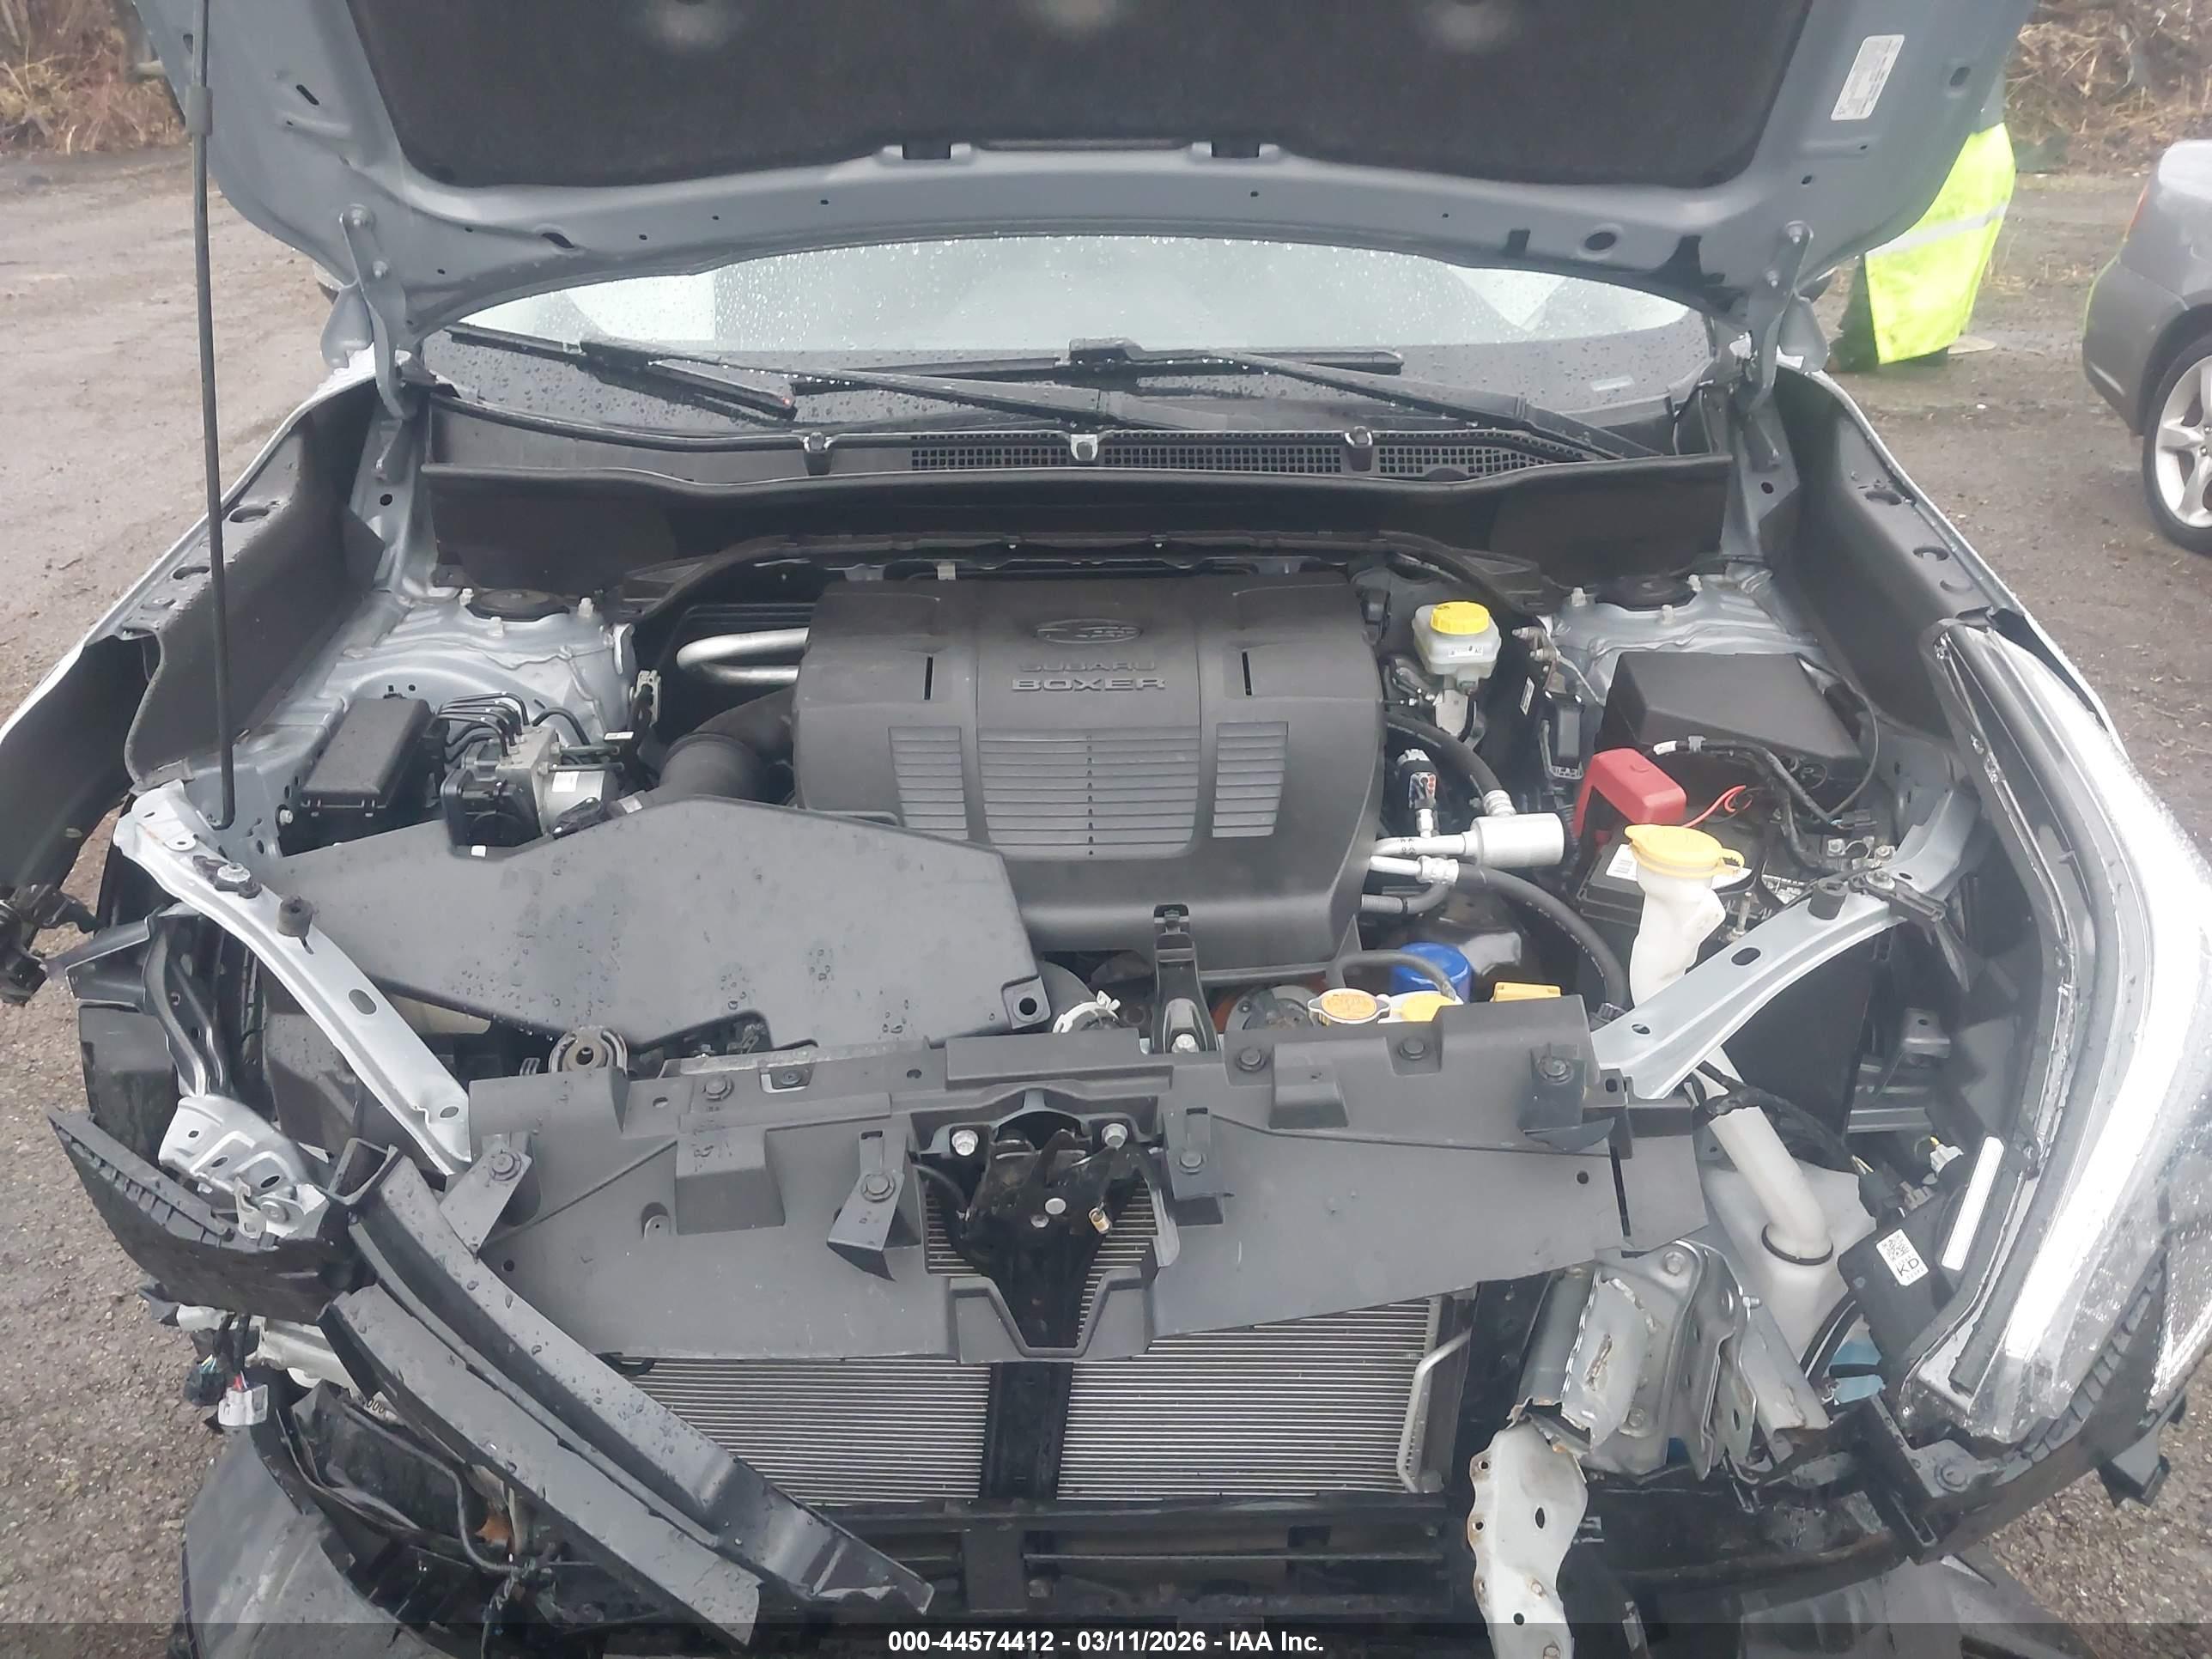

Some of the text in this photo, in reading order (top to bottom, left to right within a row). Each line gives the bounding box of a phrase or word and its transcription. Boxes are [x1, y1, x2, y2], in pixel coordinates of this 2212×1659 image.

[1020, 660, 1156, 673] SUBARU
[1012, 678, 1167, 692] BOXER
[1895, 1258, 1919, 1276] KD
